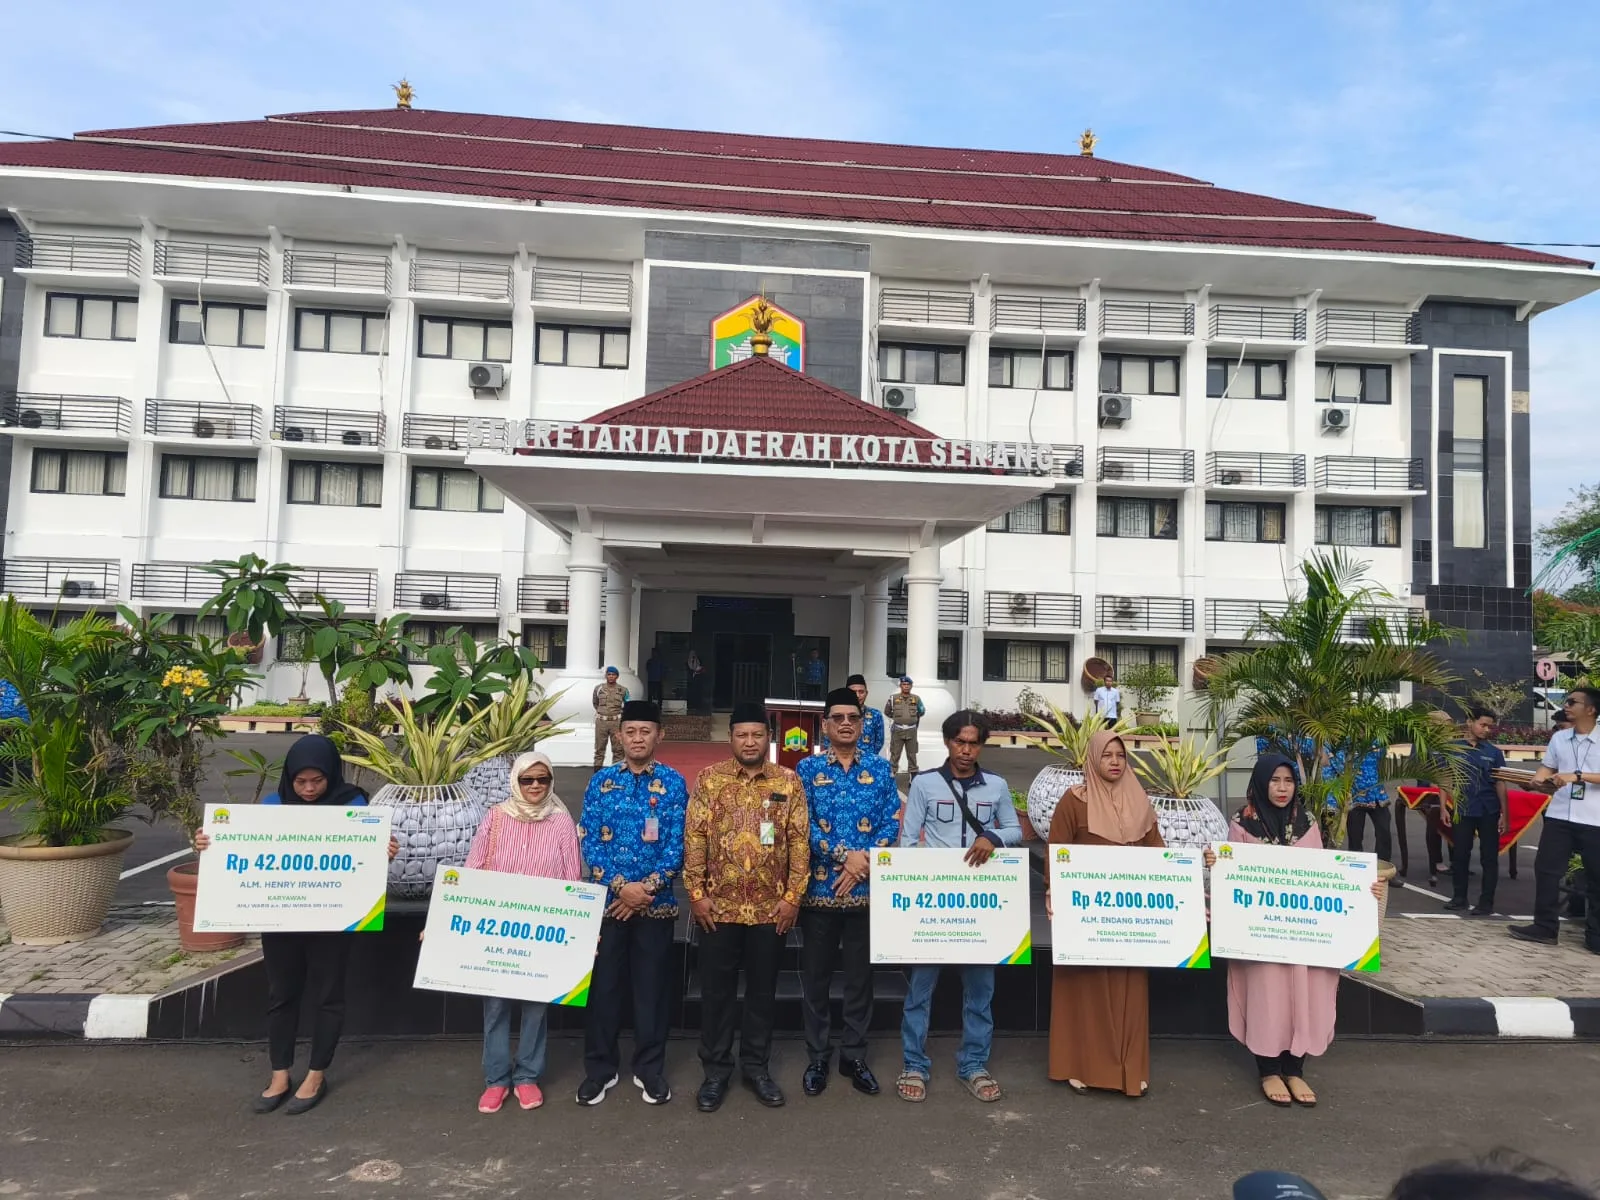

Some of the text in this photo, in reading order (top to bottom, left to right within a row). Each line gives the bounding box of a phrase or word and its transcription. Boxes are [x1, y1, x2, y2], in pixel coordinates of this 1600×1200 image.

[467, 418, 1054, 470] SEKRETARIAT DAERAH KOTA SERANG
[276, 834, 322, 842] JAMINAN
[226, 854, 364, 873] Rp 42.000.000,-
[1238, 865, 1345, 880] SANTUNAN MENINGGAL
[1061, 872, 1106, 880] SANTUNAN
[1108, 873, 1146, 881] JAMINAN
[1225, 874, 1361, 892] JAMINAN KECELAKAAN KERJA
[443, 895, 590, 918] SANTUNAN JAMINAN KEMATIAN
[892, 893, 1008, 911] Rp 42.000.000,-
[1072, 891, 1184, 911] Rp 42.000.000,-
[1233, 889, 1354, 916] Rp 70.000.000,-
[1285, 917, 1317, 925] NANING
[451, 915, 575, 946] Rp 42.000.000,-
[485, 946, 531, 957] ALM. PARLI
[487, 960, 520, 968] PETERNAK
